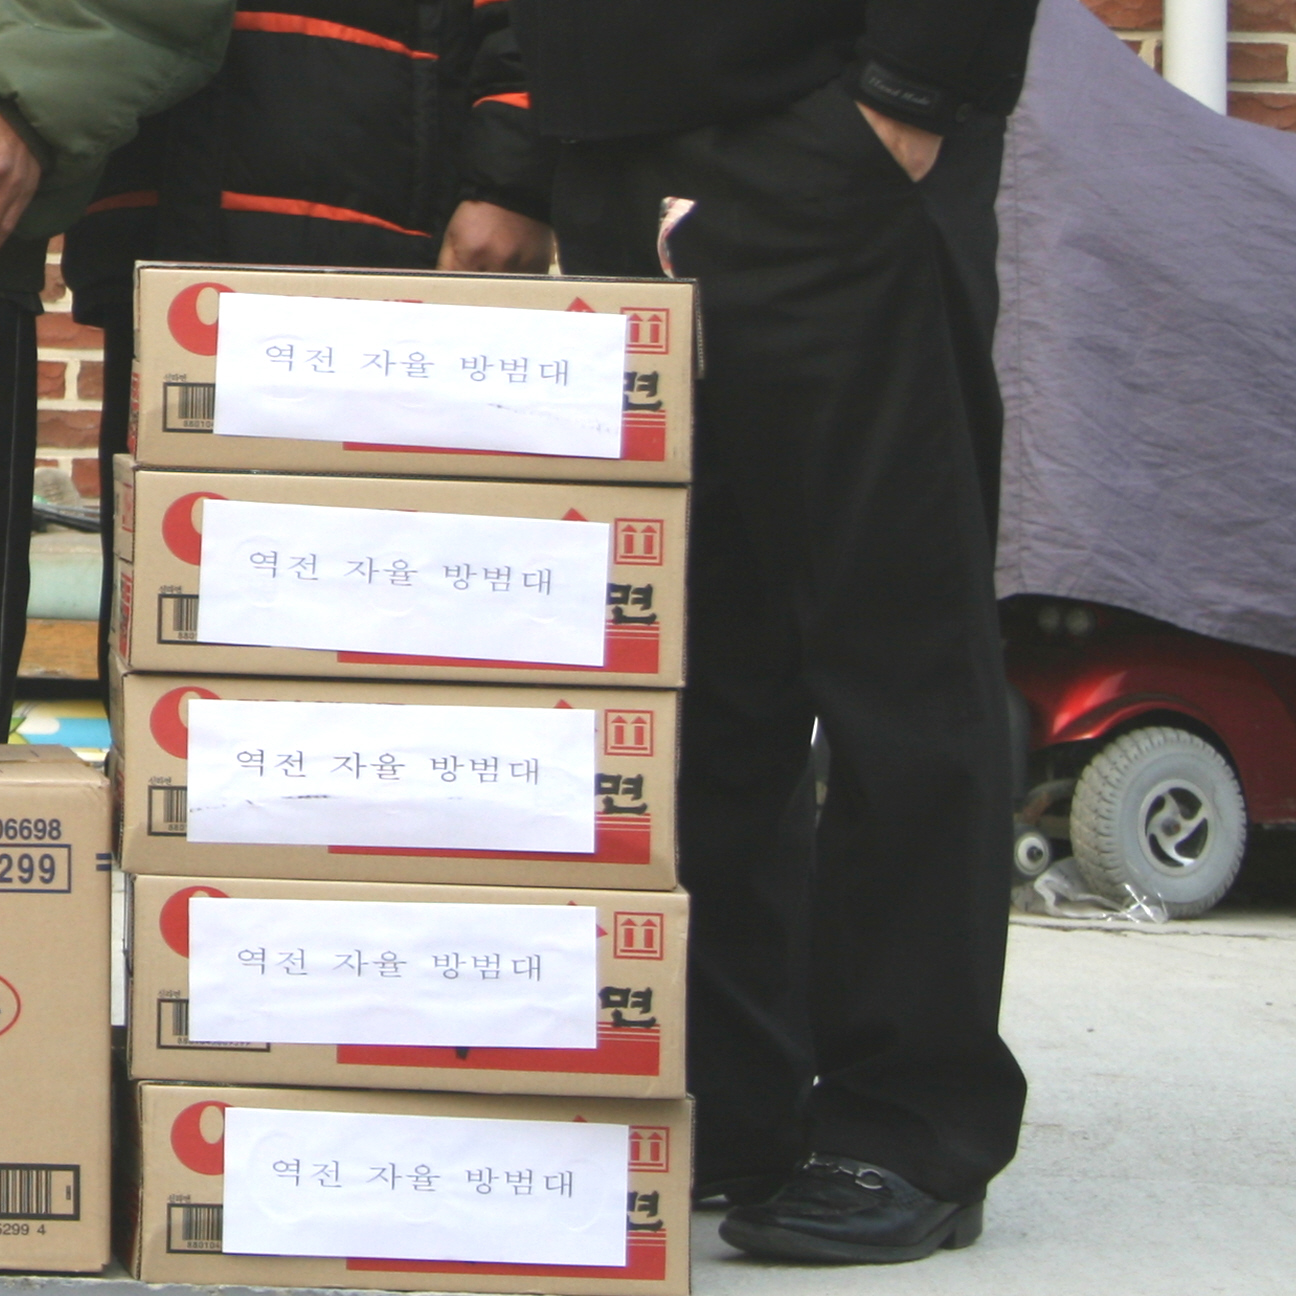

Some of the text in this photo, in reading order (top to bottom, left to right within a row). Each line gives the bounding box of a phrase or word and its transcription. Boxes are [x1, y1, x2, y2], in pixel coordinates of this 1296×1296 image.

[266, 344, 568, 386] 역전 자율 방범대
[250, 551, 551, 595] 역전 자율 방범대
[237, 749, 538, 785] 역전 자율 방범대
[238, 947, 540, 981] 역전 자율 방범대
[273, 1159, 572, 1198] 역전 자율 방범대
[37, 1224, 46, 1235] 4
